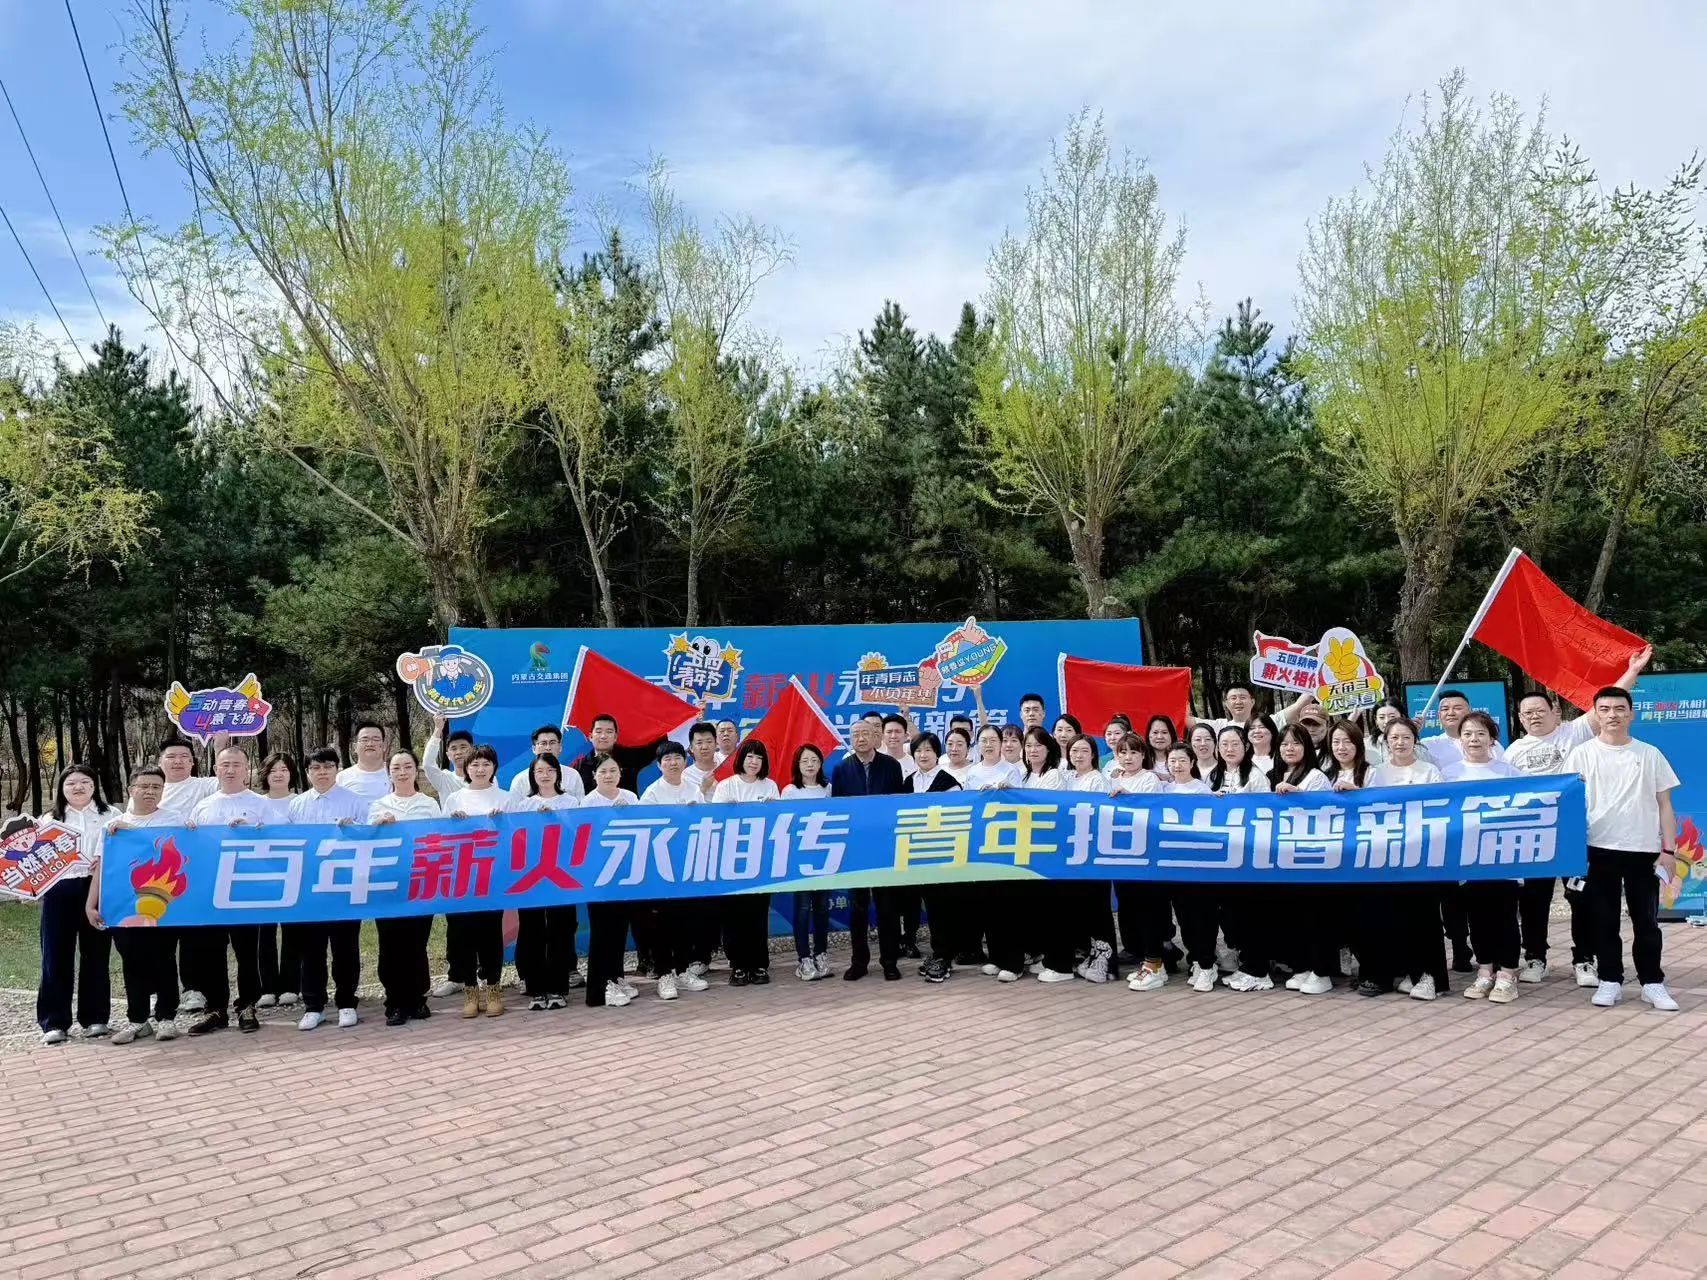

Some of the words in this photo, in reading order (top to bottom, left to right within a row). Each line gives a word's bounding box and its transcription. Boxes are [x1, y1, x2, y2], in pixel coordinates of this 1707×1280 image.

[683, 650, 722, 671] 五四
[1276, 651, 1319, 670] 五四精神
[511, 672, 569, 681] 内蒙古交通集团
[672, 666, 724, 691] 青年节
[186, 694, 248, 712] 5动青春
[427, 681, 484, 706] 新时代青年
[870, 685, 932, 701] 不负年华
[1, 832, 76, 889] 当燃青春
[212, 811, 850, 910] 百年薪火永相传
[893, 791, 1562, 872] 青年担当谱新篇
[30, 871, 50, 886] GO!
[49, 859, 68, 873] GO!
